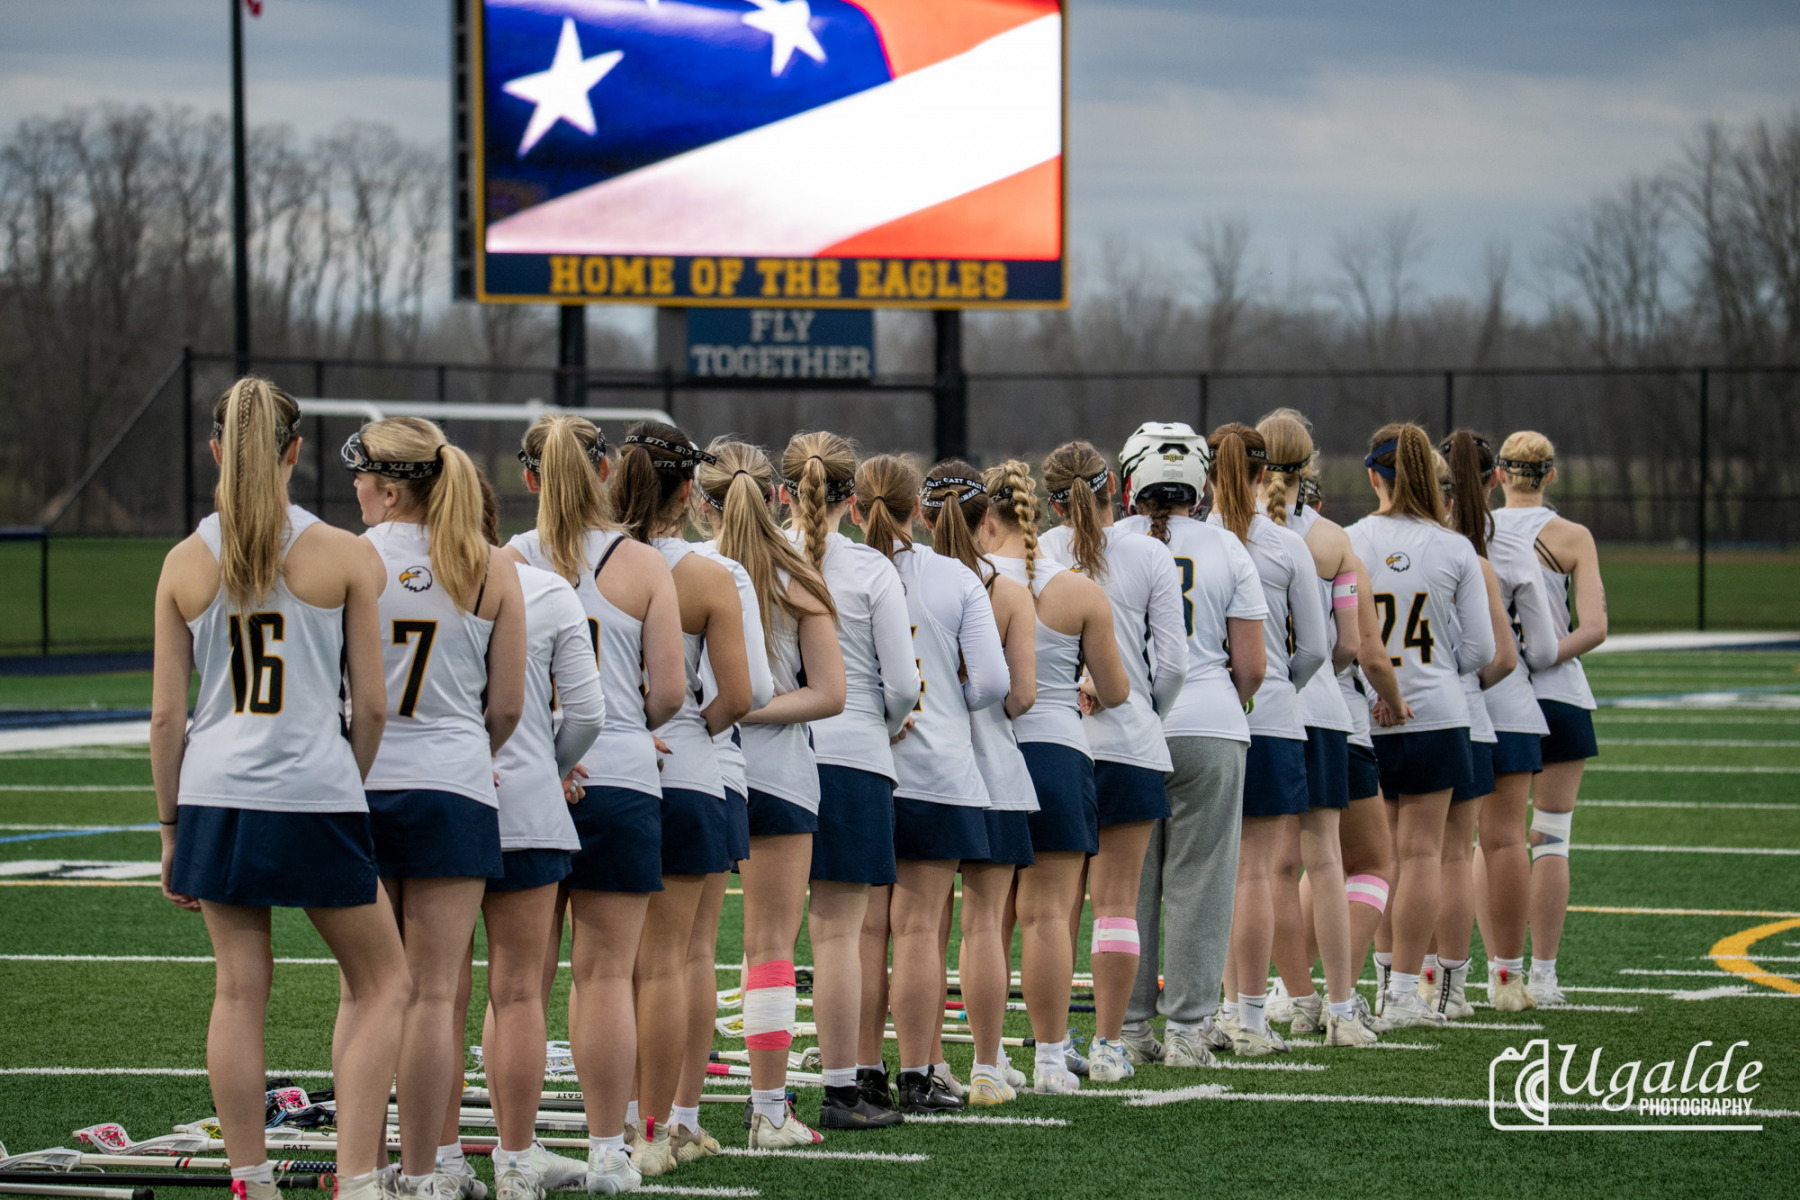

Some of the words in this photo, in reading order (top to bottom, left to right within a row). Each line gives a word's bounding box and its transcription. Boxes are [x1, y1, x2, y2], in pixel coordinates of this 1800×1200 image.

[549, 256, 675, 294] HOME
[690, 257, 745, 295] OF
[757, 259, 841, 297] THE
[857, 260, 1008, 298] EAGLES
[750, 311, 815, 343] FLY
[691, 345, 873, 378] TOGETHER
[645, 436, 669, 448] STX
[675, 445, 693, 457] STX
[228, 611, 285, 716] 16
[391, 619, 438, 718] 7
